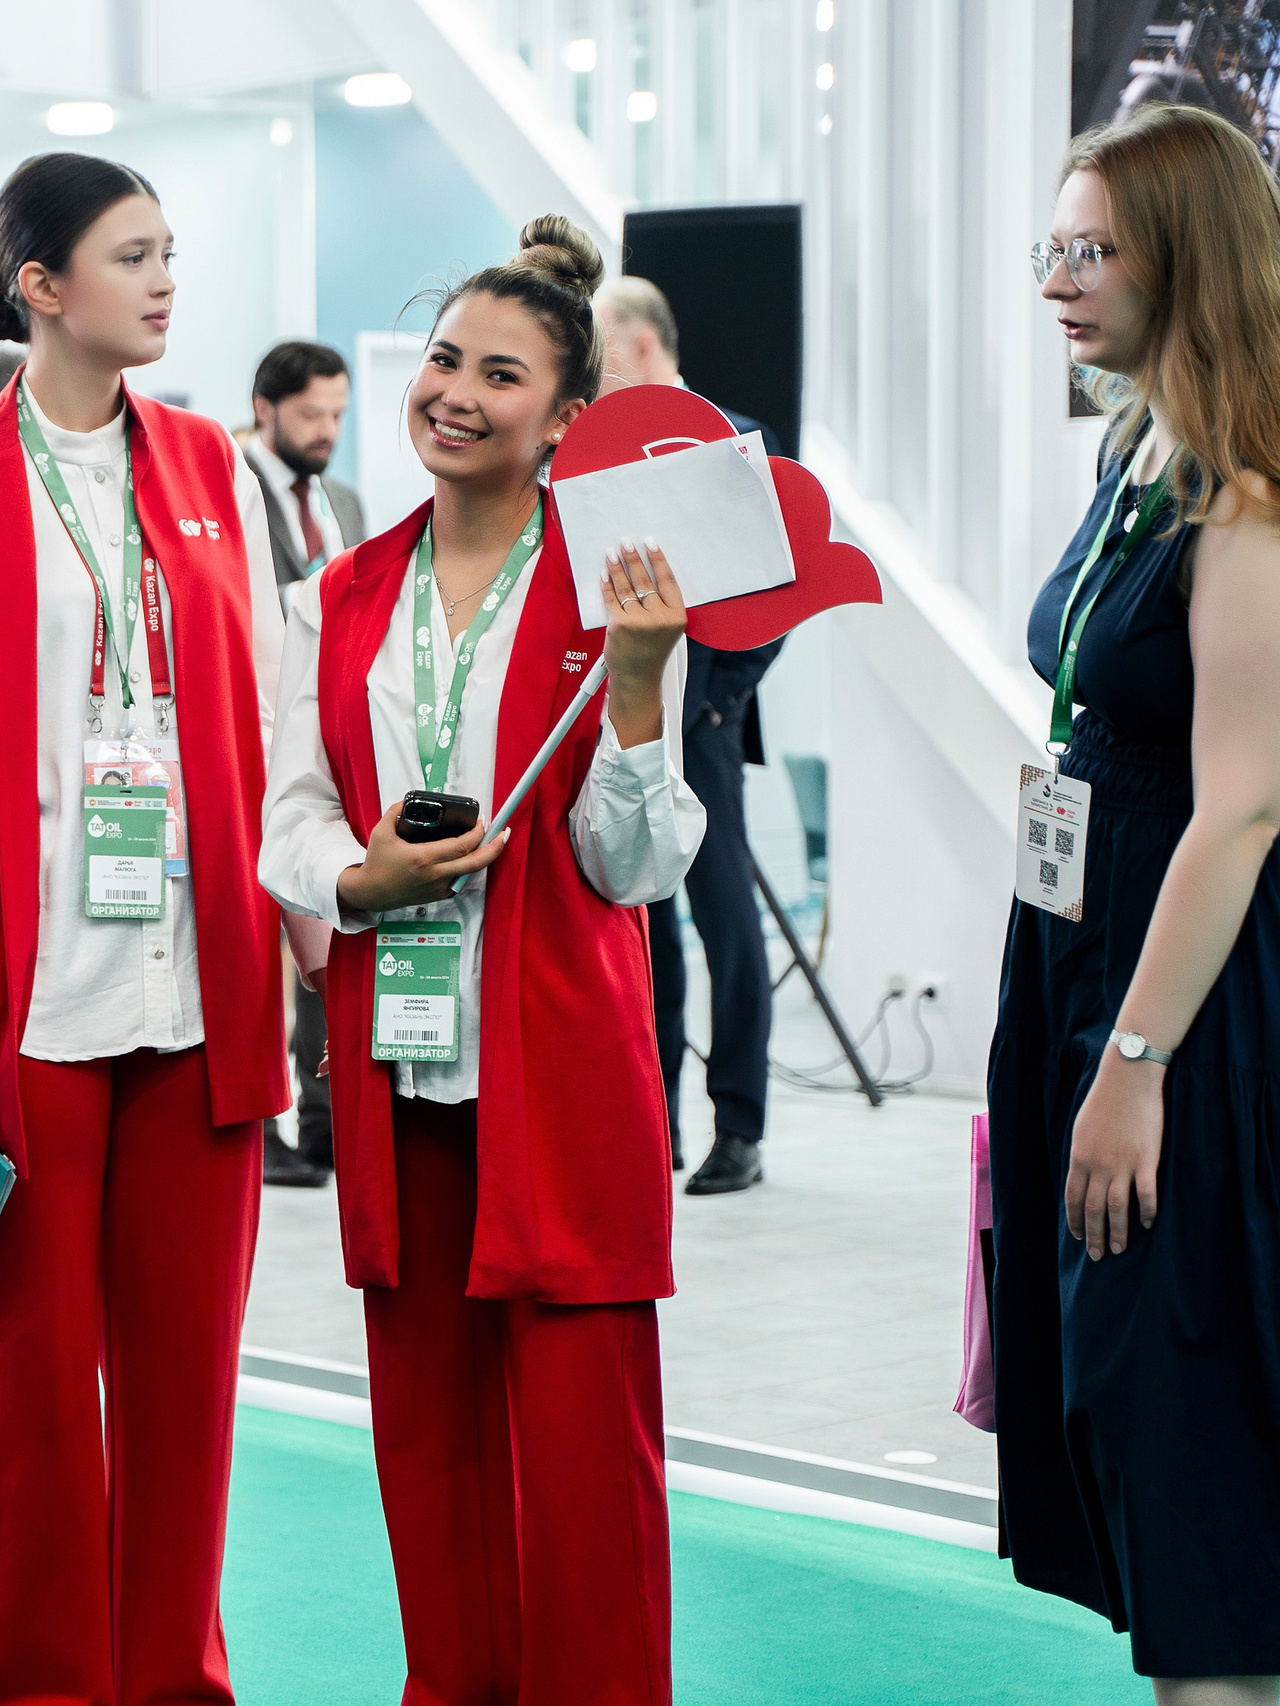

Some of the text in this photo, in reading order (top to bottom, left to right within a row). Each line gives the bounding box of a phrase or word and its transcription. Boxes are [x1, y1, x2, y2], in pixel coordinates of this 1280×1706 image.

[492, 572, 507, 590] Kazan
[500, 577, 512, 591] Expo
[145, 575, 159, 632] Kazan Expo
[96, 616, 104, 647] Kazan
[443, 701, 453, 722] Kazan
[449, 705, 457, 722] Expo
[91, 906, 160, 916] ОРГАНИЗАТОР
[378, 1048, 451, 1058] ОРГАНИЗАТОР
